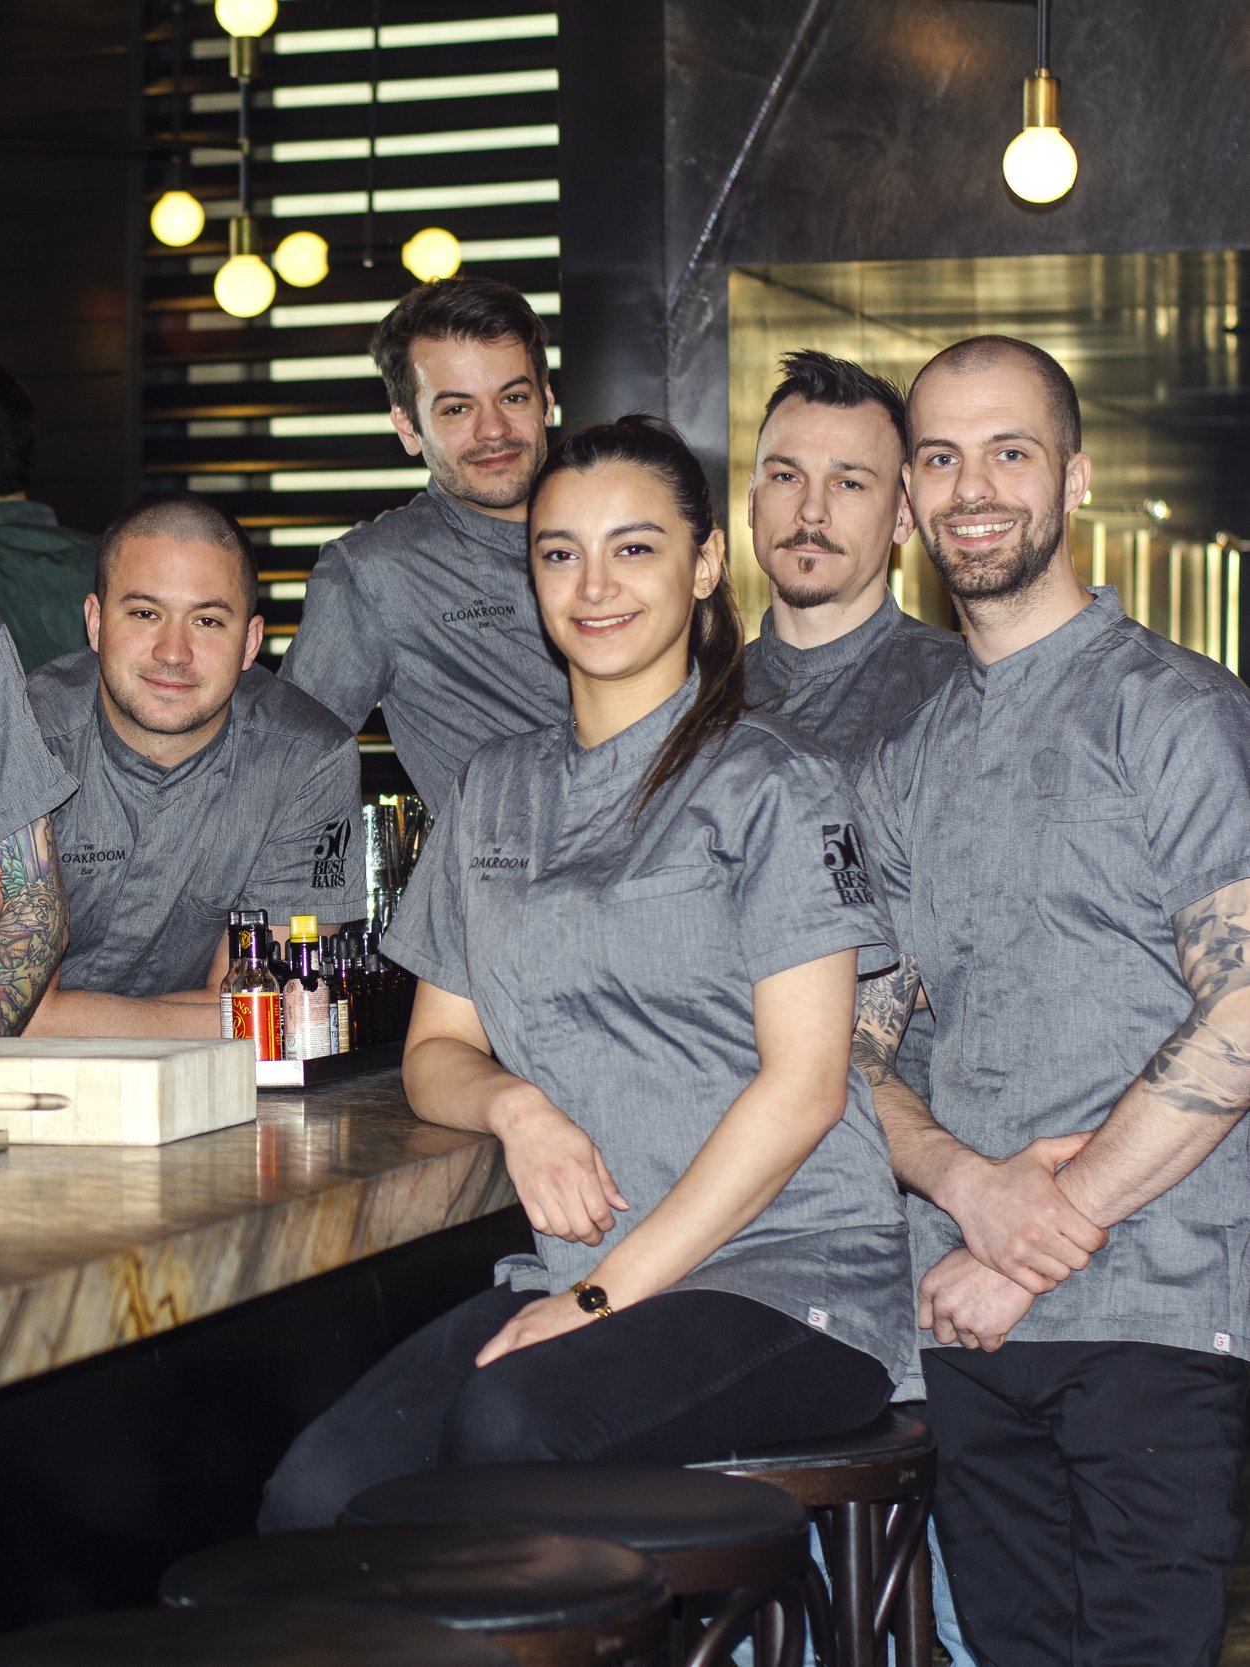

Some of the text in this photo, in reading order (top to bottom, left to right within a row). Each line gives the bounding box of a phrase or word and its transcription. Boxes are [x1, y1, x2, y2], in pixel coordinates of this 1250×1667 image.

[442, 605, 516, 622] CLOAKROOM
[314, 817, 352, 861] 50
[821, 823, 867, 871] 50
[312, 858, 347, 875] BEST
[311, 873, 346, 888] BARS
